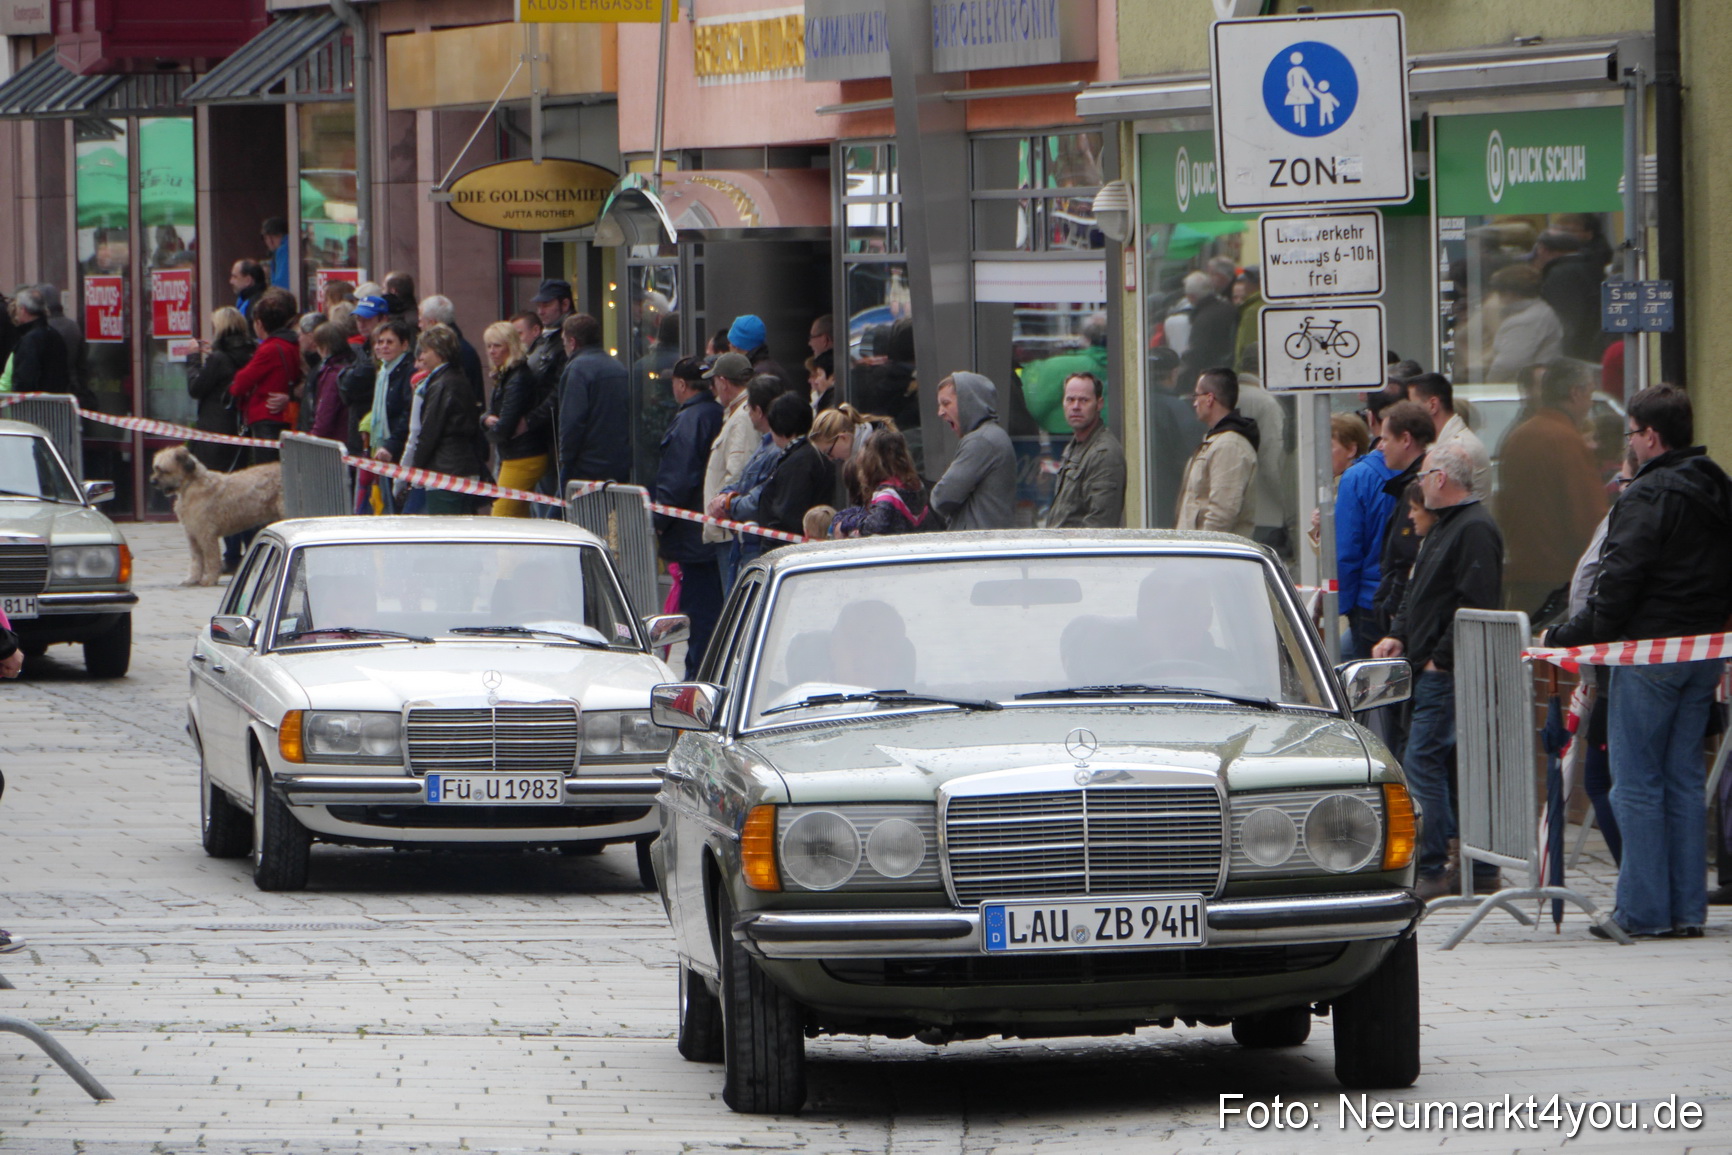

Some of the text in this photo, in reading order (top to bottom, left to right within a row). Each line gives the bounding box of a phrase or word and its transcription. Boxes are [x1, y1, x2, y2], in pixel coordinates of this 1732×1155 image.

[1508, 147, 1544, 186] QUICK
[1546, 145, 1585, 182] SCHUH
[457, 190, 486, 203] DIE
[503, 209, 575, 219] JUTTA ROTHER
[1309, 270, 1338, 287] frei
[1304, 362, 1342, 382] frei
[443, 779, 471, 800] FÜ
[1009, 909, 1069, 944] LAU
[1094, 907, 1134, 941] ZB
[992, 932, 1000, 943] D
